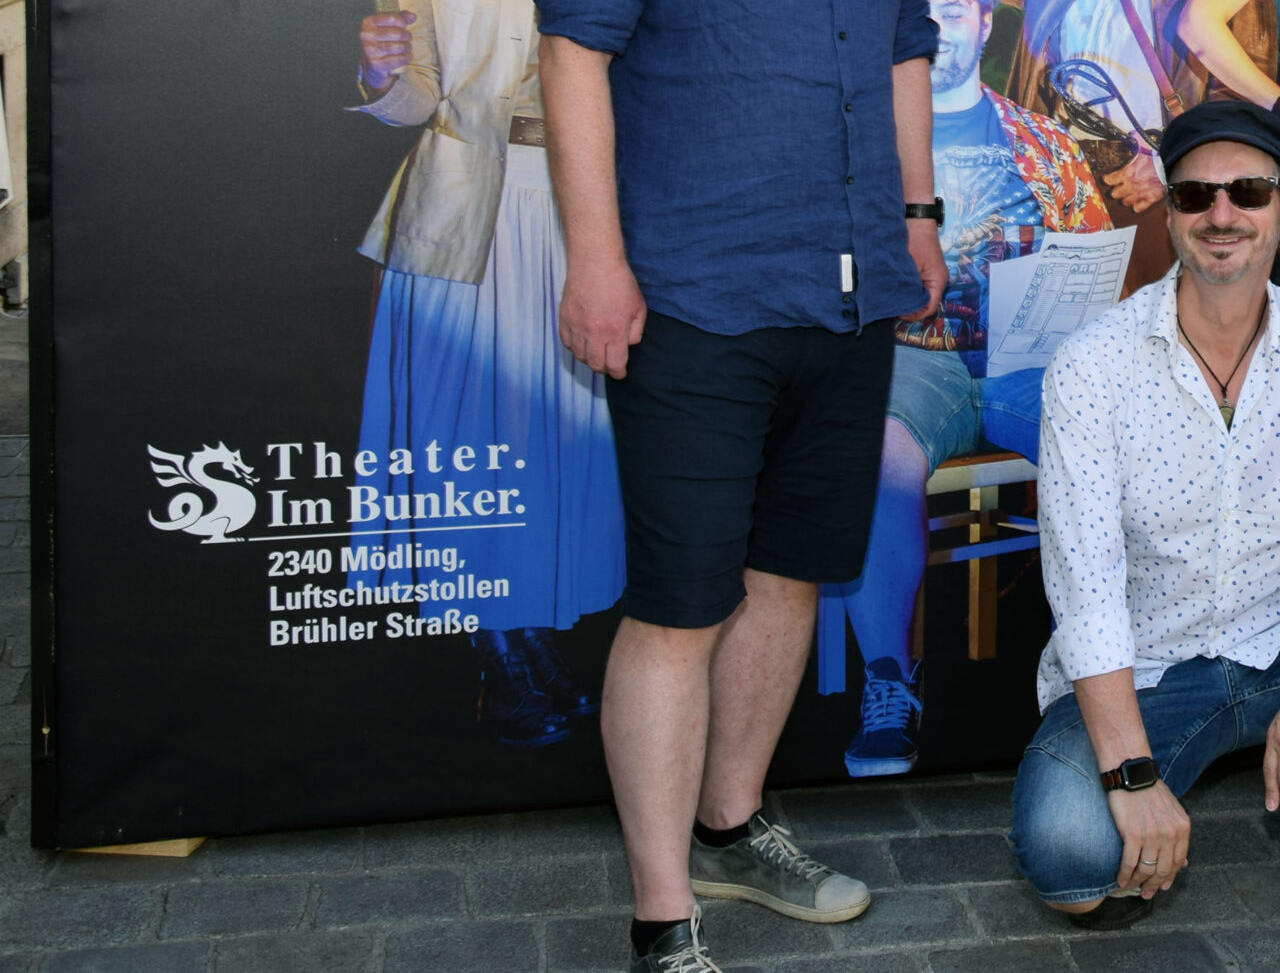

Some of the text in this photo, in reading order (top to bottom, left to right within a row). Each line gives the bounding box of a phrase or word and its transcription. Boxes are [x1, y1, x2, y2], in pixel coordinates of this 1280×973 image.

[267, 439, 526, 482] Theater.
[267, 481, 527, 528] Im Bunker.
[268, 543, 466, 577] 2340 Mödling,
[269, 575, 510, 612] Luftschutzstollen
[270, 608, 480, 647] Brühler Straße
